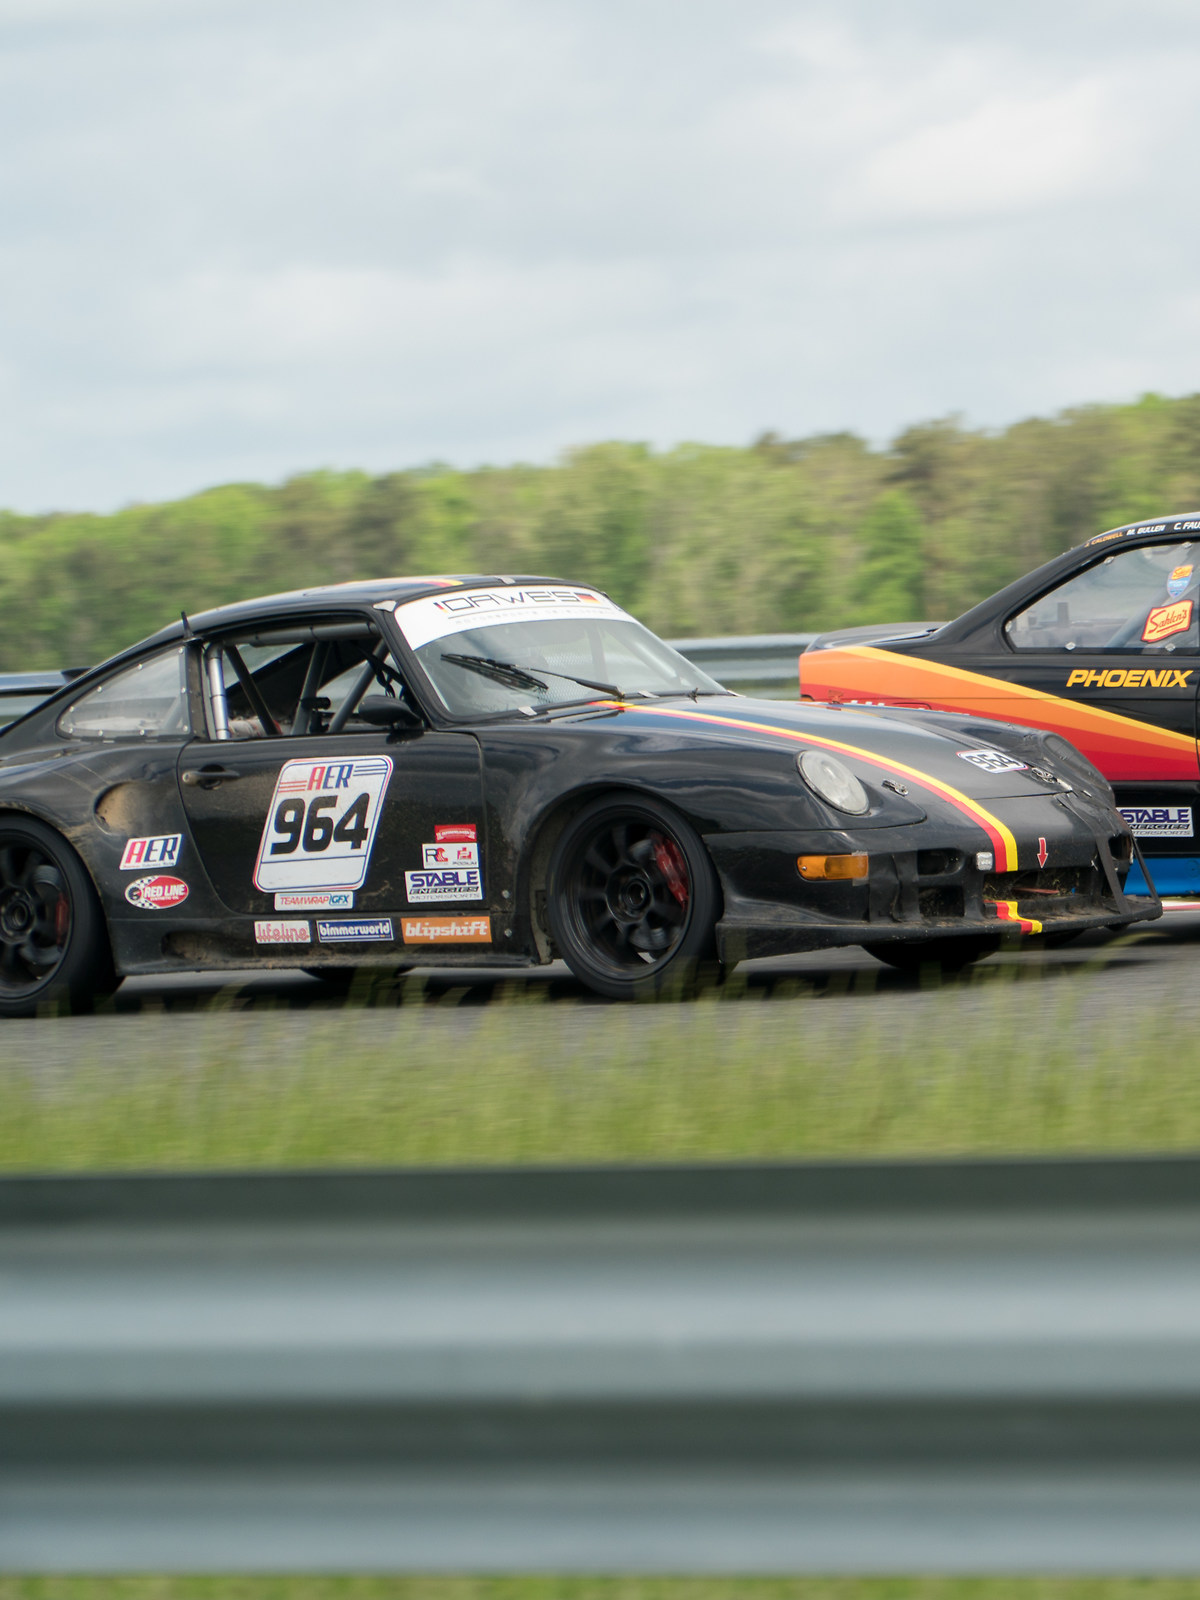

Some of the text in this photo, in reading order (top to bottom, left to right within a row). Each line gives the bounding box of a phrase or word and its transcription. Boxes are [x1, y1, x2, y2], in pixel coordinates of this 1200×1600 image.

[1065, 669, 1194, 688] PHOENIX
[307, 764, 354, 790] AER
[270, 792, 371, 856] 964
[1120, 809, 1190, 823] STABLE
[125, 837, 179, 864] AER
[410, 870, 479, 888] STABLE
[144, 884, 185, 898] RED LINE
[408, 886, 480, 895] ENERGIES
[319, 921, 390, 936] bimmerworld
[405, 921, 488, 940] blipshift
